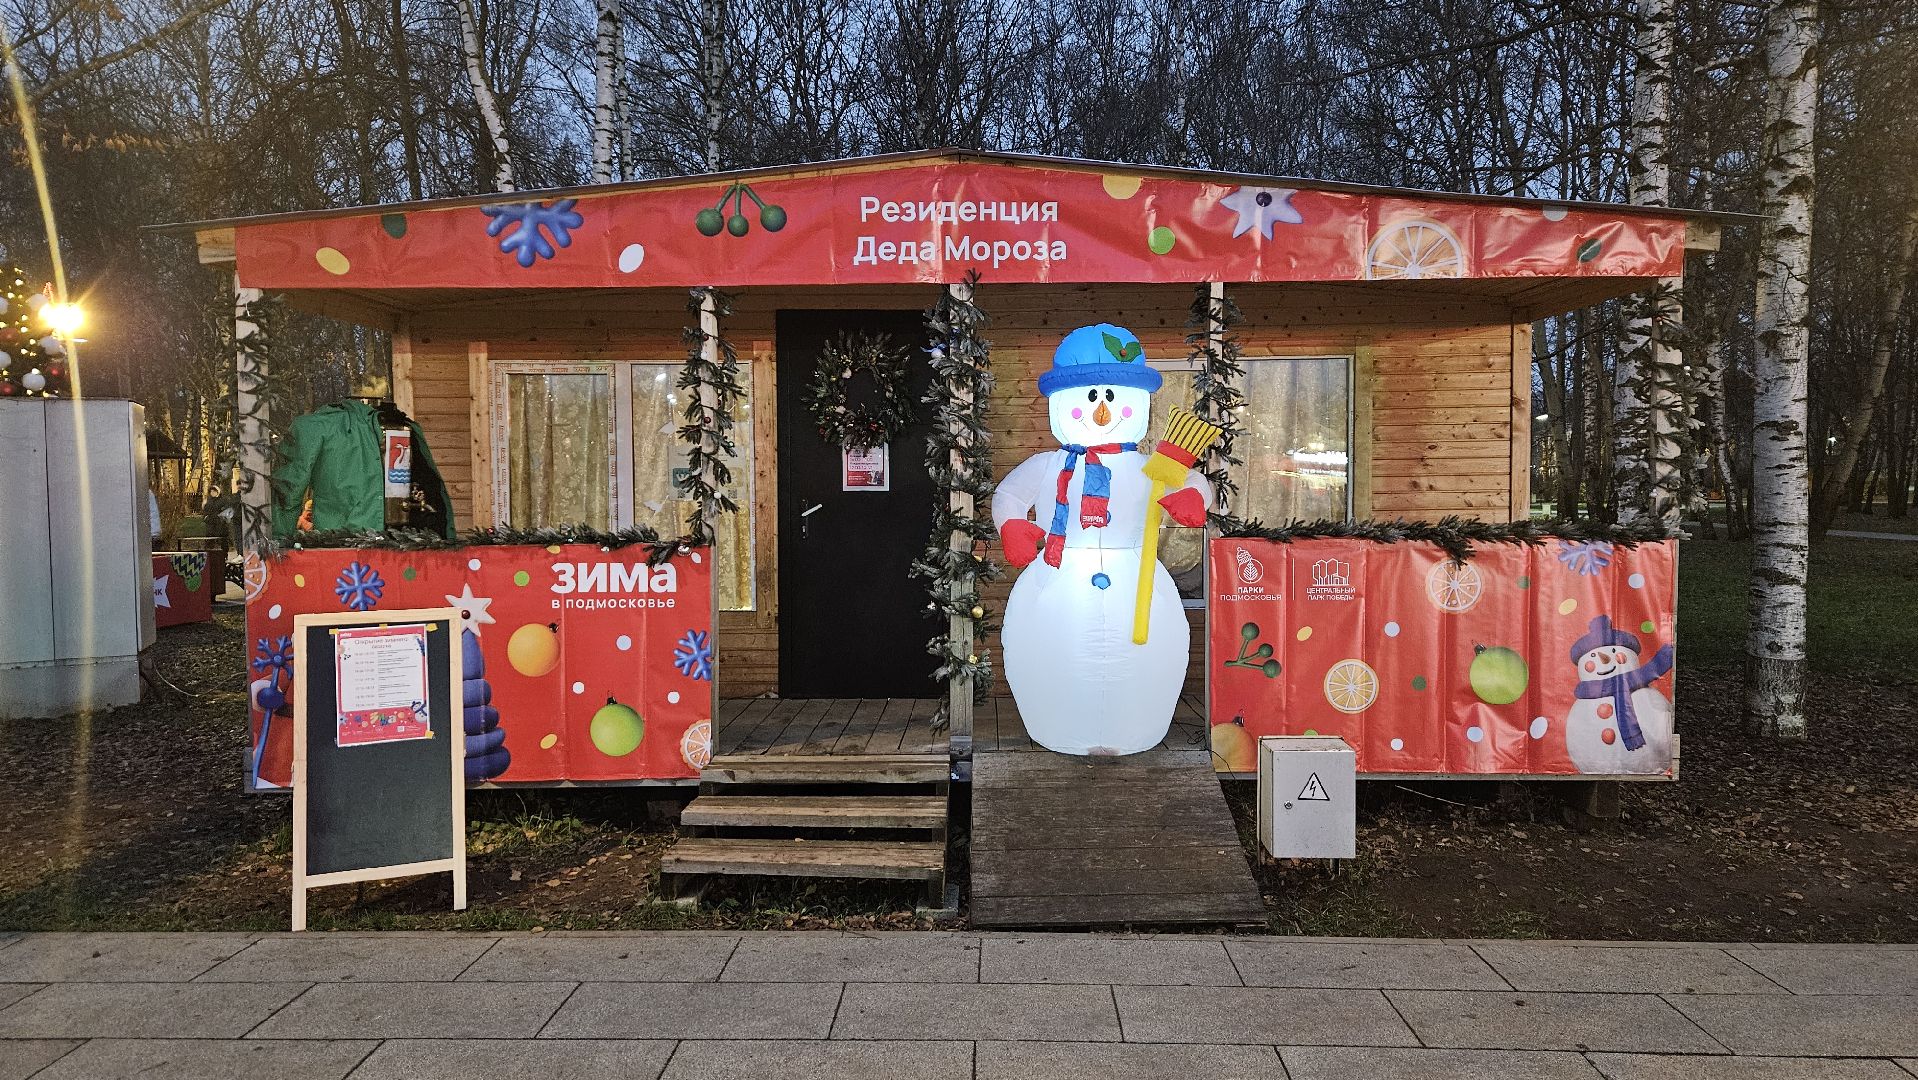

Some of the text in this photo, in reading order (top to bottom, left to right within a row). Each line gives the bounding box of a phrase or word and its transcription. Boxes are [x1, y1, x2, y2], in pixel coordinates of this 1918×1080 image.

[860, 196, 1058, 225] Резиденция
[853, 235, 1067, 268] Деда Мороза
[1306, 586, 1356, 594] ЦЕНТРАЛЬНЫЙ
[551, 598, 675, 611] в подмосковье
